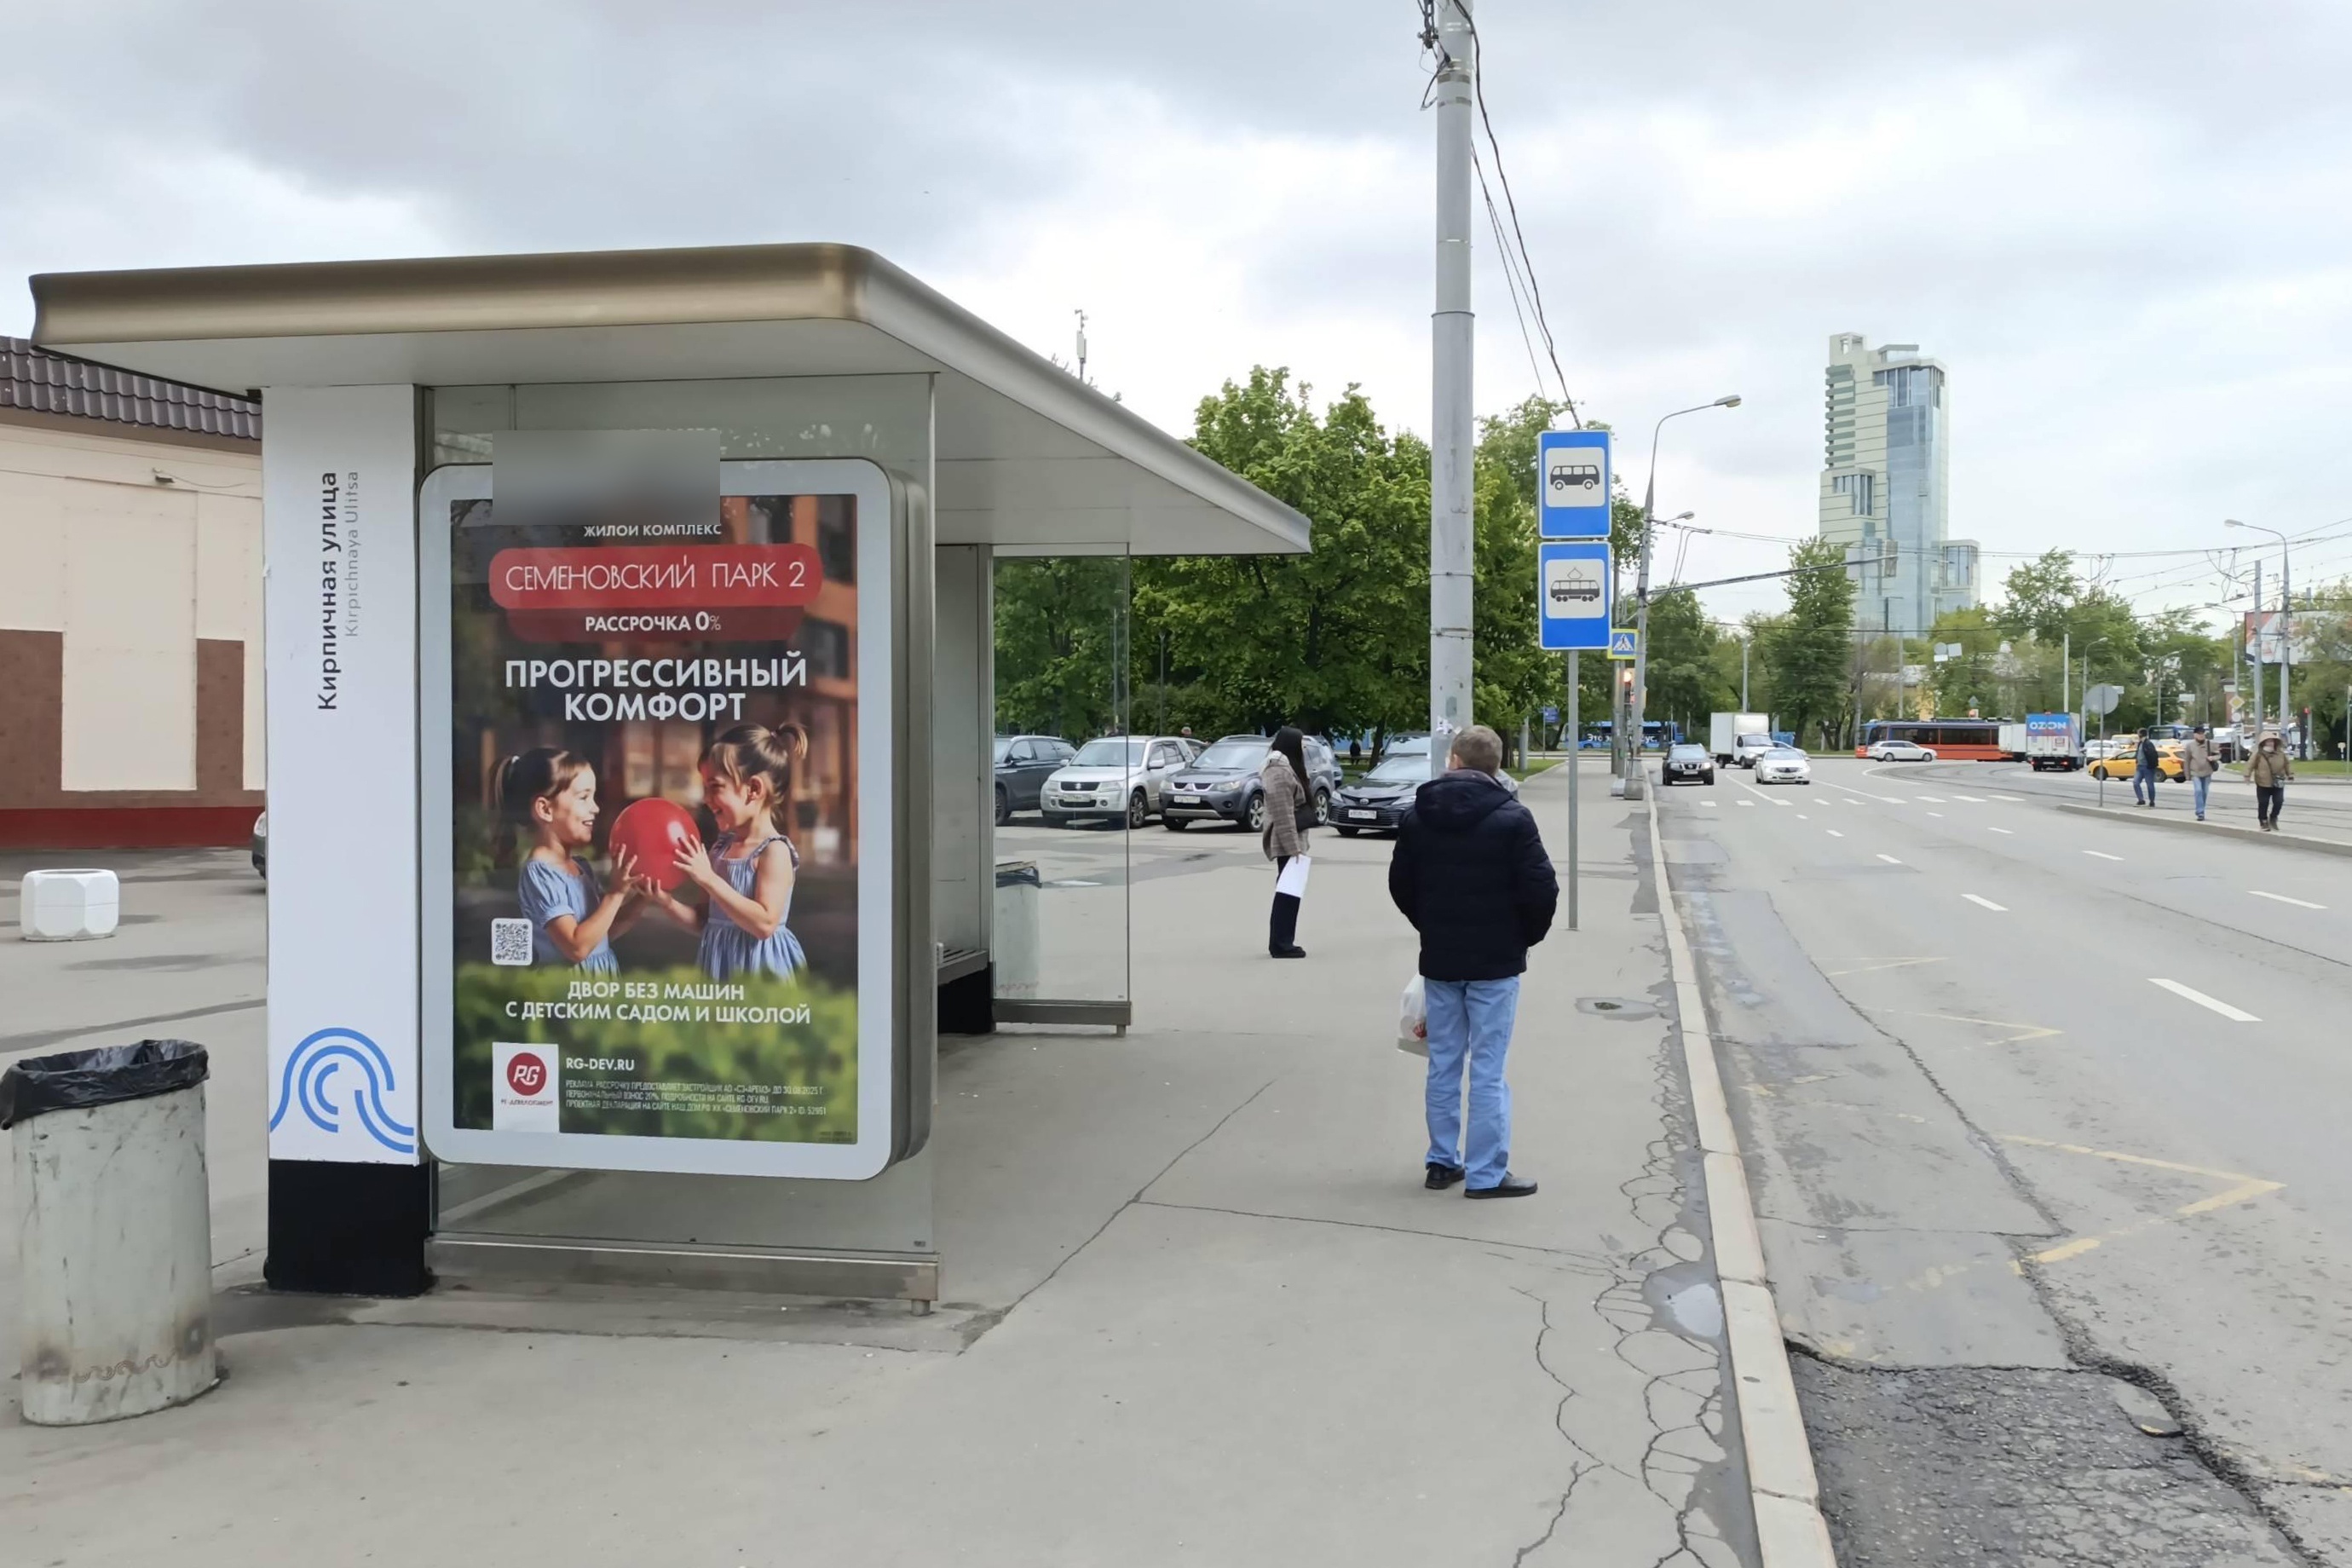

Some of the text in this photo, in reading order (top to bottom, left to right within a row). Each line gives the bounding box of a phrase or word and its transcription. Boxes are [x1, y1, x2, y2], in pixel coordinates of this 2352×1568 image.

[643, 524, 722, 536] КОМПЛЕКС
[344, 471, 361, 637] Kirpichnaya Ulitsa
[505, 554, 805, 591] СЕМЕНОВСКИЙ ПАРК 2
[318, 472, 342, 710] Кирпичная улица
[585, 610, 722, 631] РАССРОЧКА 0%
[506, 650, 806, 688] ПРОГРЕССИВНЫЙ
[565, 692, 746, 721] КОМФОРТ
[568, 981, 745, 1000] ДВОР БЕЗ МАШИН
[505, 1001, 810, 1024] С ДЕТСКИМ САДОМ И ШКОЛОЙ
[513, 1064, 541, 1087] RG
[565, 1058, 635, 1071] RG-DEV.RU
